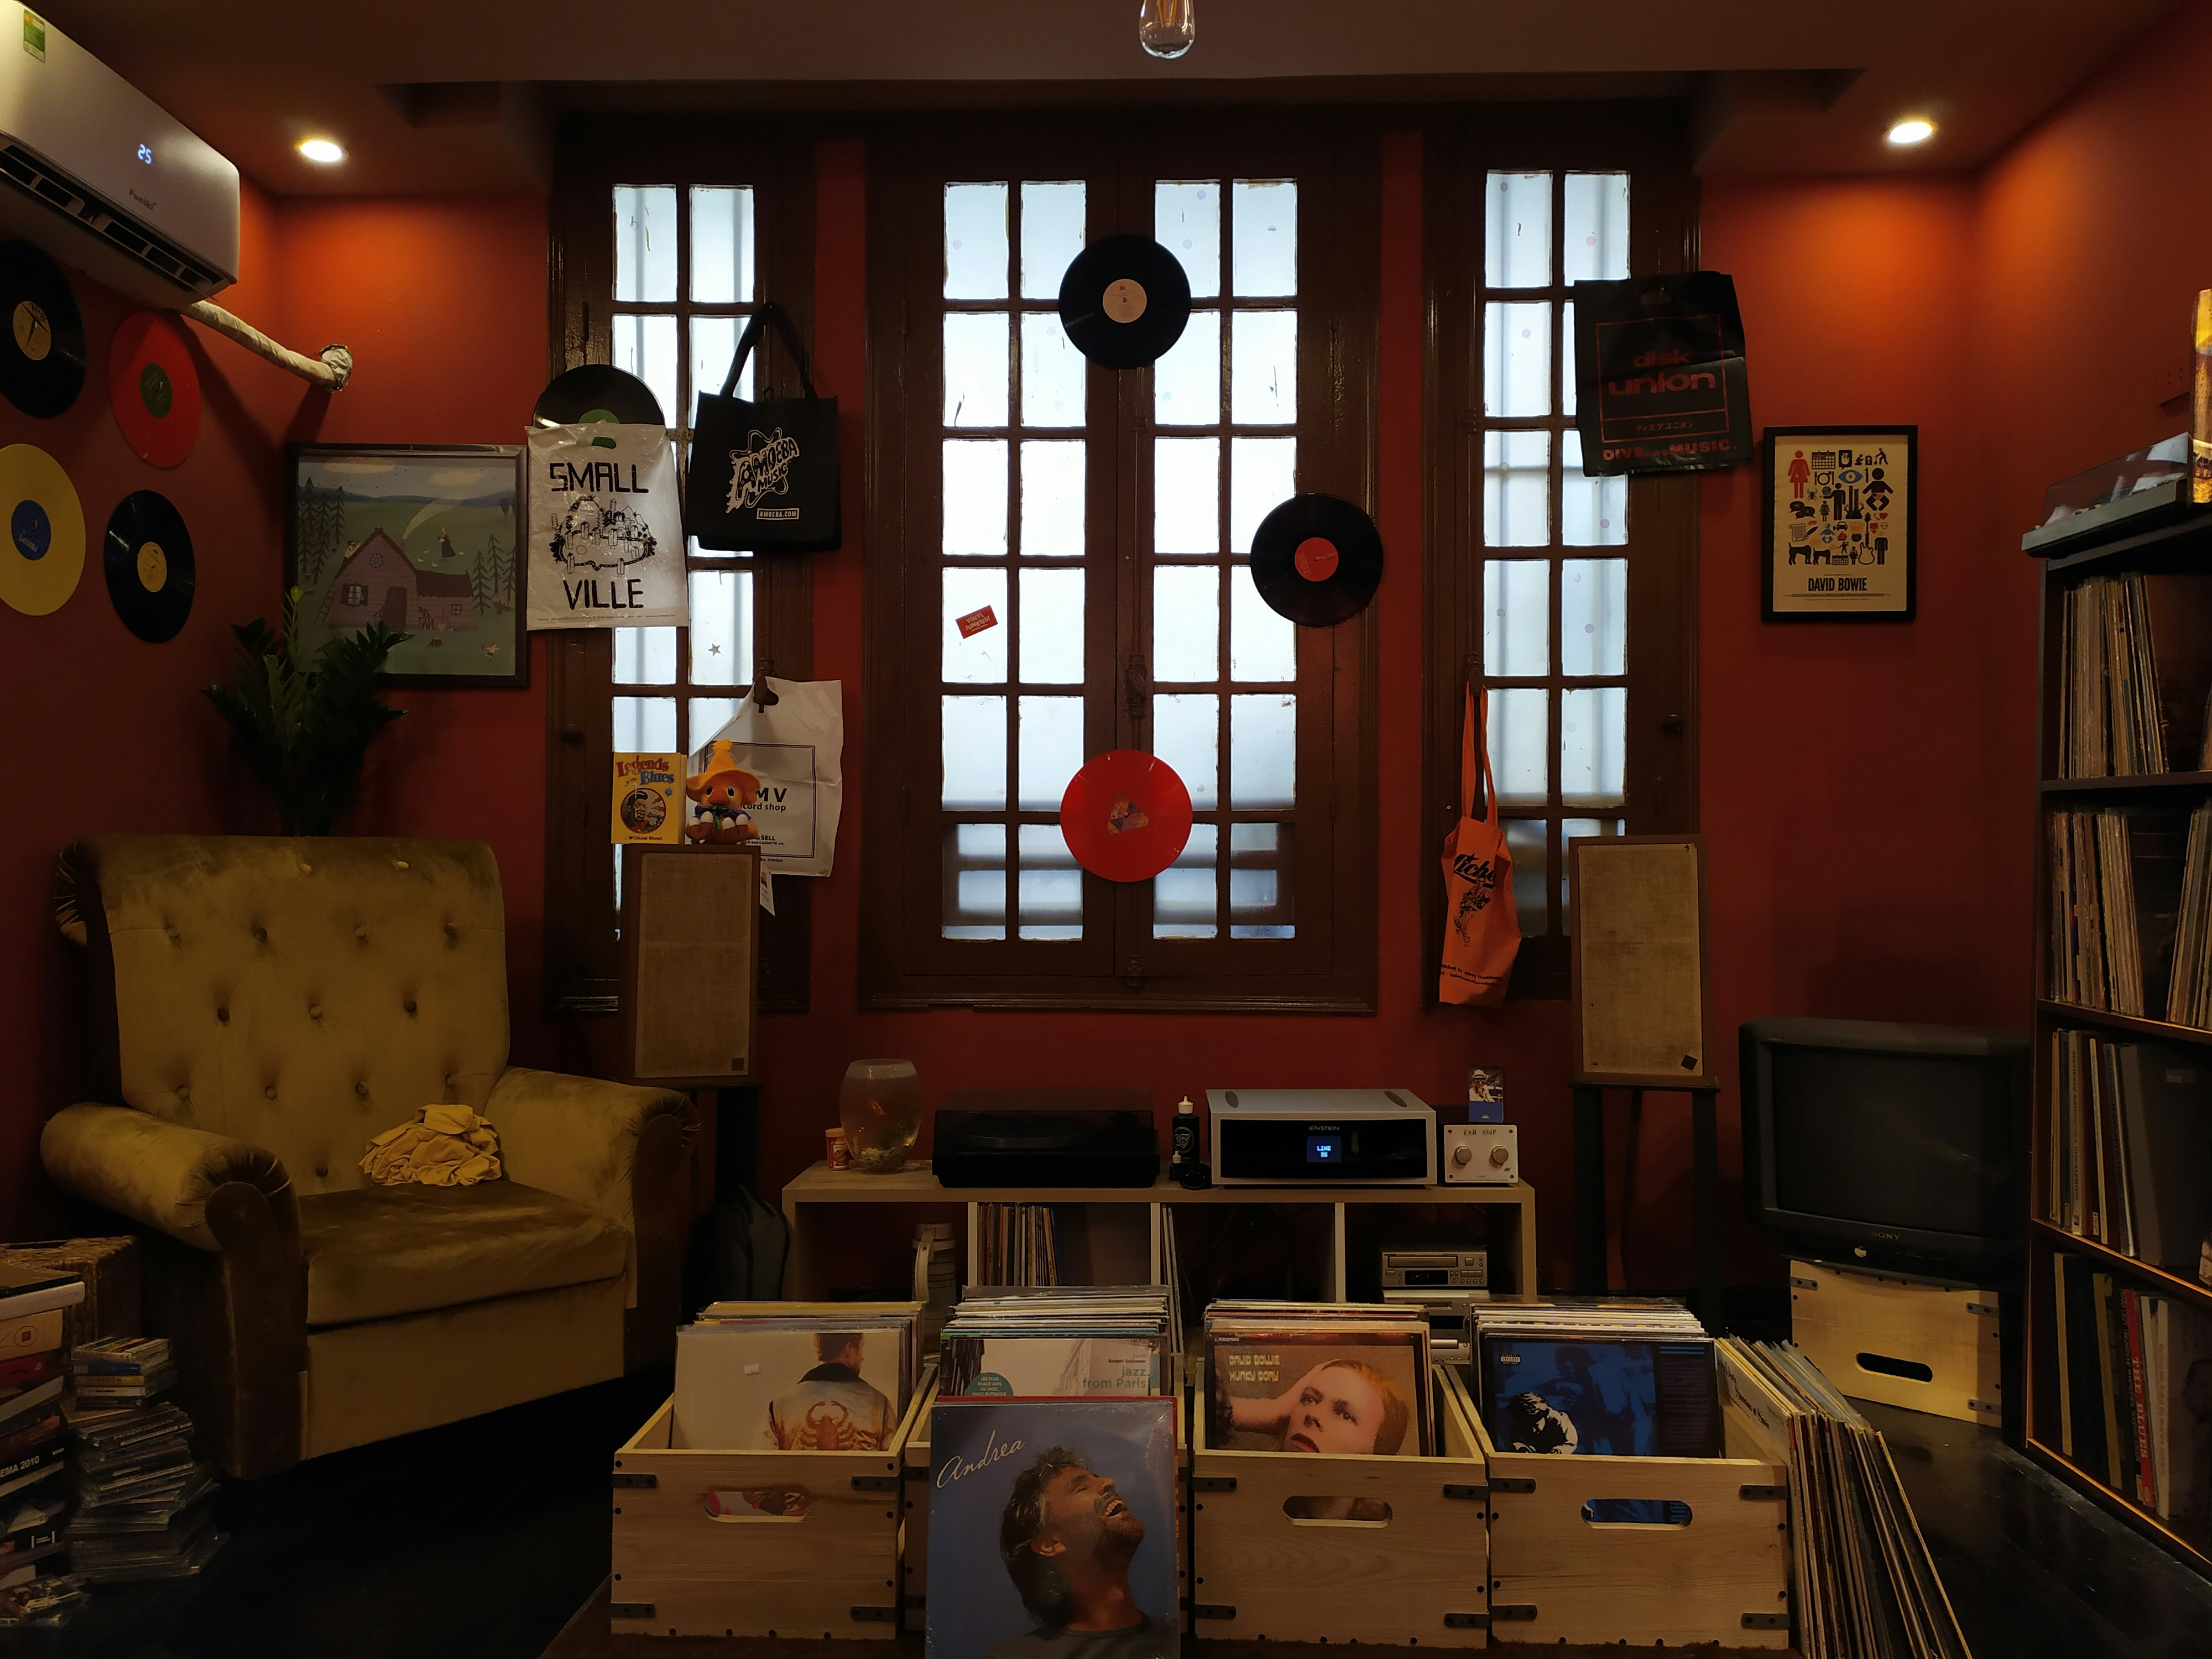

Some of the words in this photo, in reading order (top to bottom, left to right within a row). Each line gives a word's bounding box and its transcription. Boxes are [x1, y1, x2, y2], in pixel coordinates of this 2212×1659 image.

[138, 143, 152, 165] 25
[1632, 348, 1690, 368] disk
[1608, 371, 1716, 397] union
[1636, 421, 1694, 432] ディスクユニオン
[1602, 446, 1645, 461] DIVE
[550, 462, 649, 493] SMALL
[735, 439, 797, 500] AMOEBA
[757, 462, 788, 493] MUSIC
[563, 578, 644, 610] VILLE
[1808, 577, 1835, 592] DAVID
[1838, 577, 1867, 591] BOWIE
[966, 612, 985, 624] VINYL
[615, 755, 669, 778] Legends
[639, 770, 675, 785] Blues
[755, 787, 787, 802] MV
[765, 803, 786, 812] shop
[1229, 1354, 1251, 1366] DAVID
[1254, 1354, 1280, 1365] BOWIE
[1082, 1378, 1112, 1388] from
[1117, 1378, 1146, 1389] Paris
[1229, 1370, 1256, 1381] HUNKY
[1258, 1370, 1280, 1382] DORY
[2132, 1357, 2142, 1394] THE
[2136, 1403, 2148, 1458] BLUES
[0, 1464, 19, 1478] EMA
[20, 1455, 40, 1470] 2010
[936, 1430, 1026, 1489] Andrea
